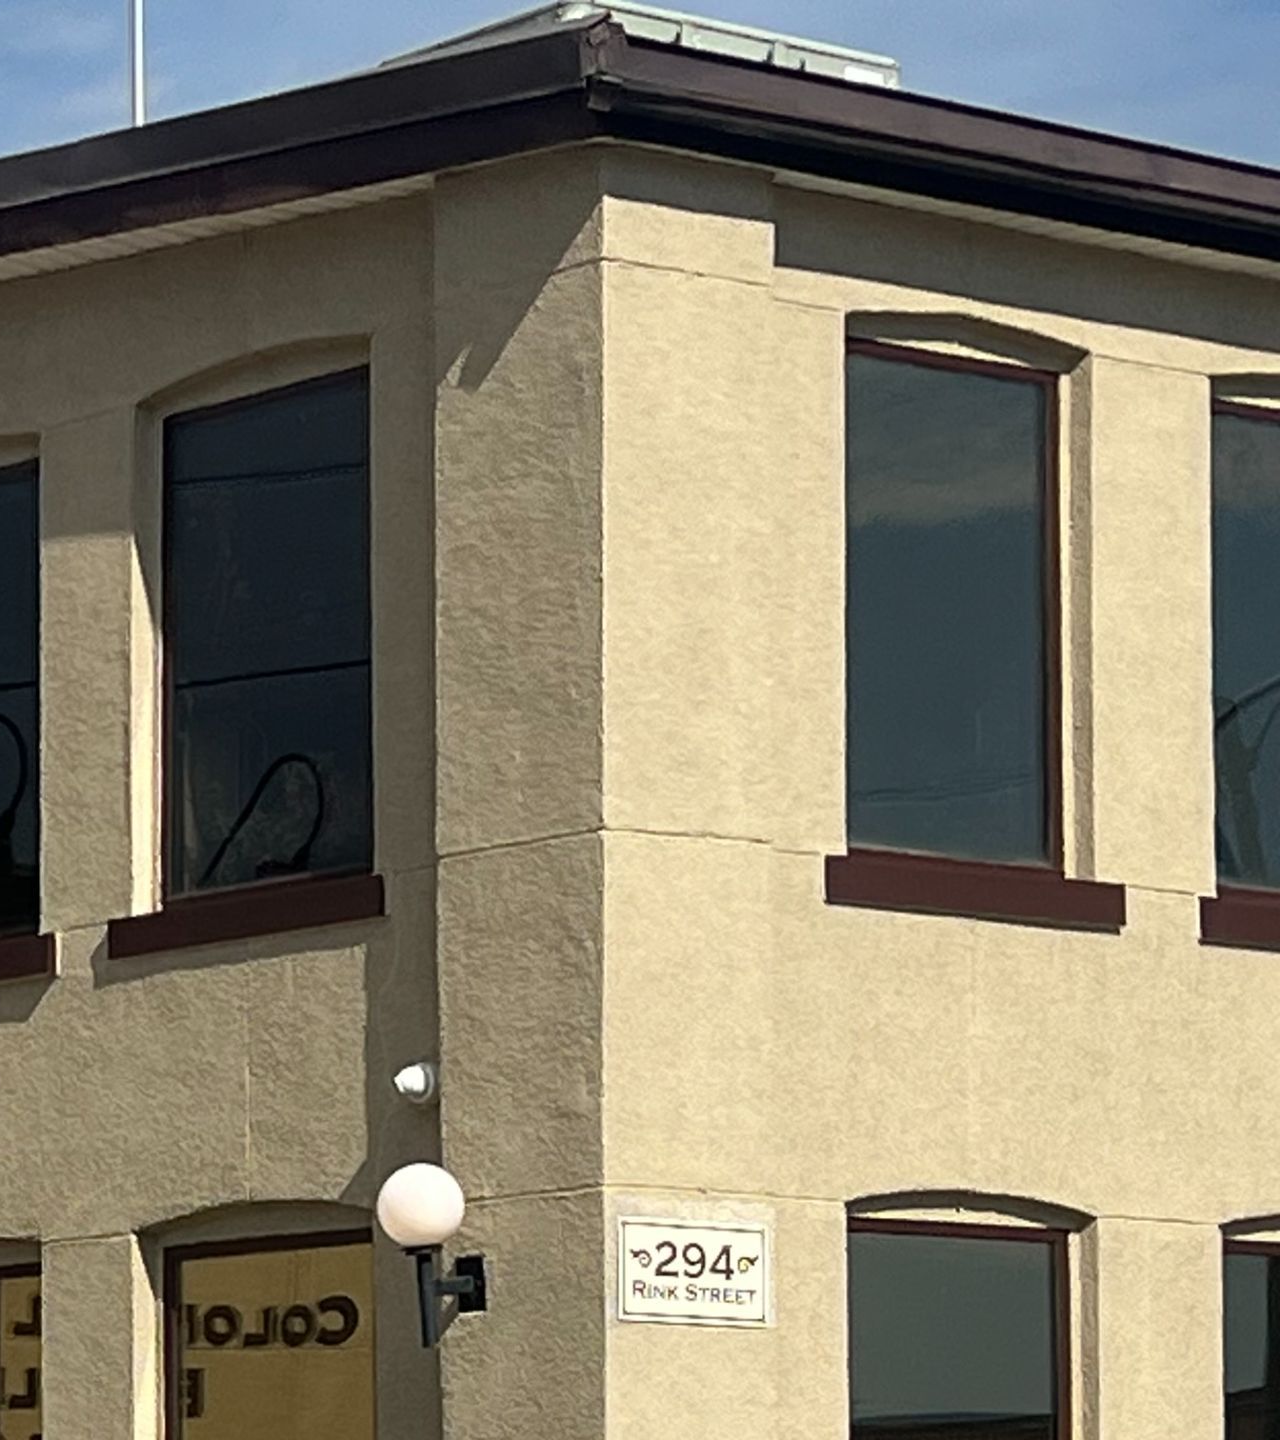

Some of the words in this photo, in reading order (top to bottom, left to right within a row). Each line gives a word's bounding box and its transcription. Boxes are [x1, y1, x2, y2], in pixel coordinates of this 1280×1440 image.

[654, 1240, 735, 1281] 294
[632, 1279, 680, 1301] RINK
[685, 1284, 757, 1305] STREET
